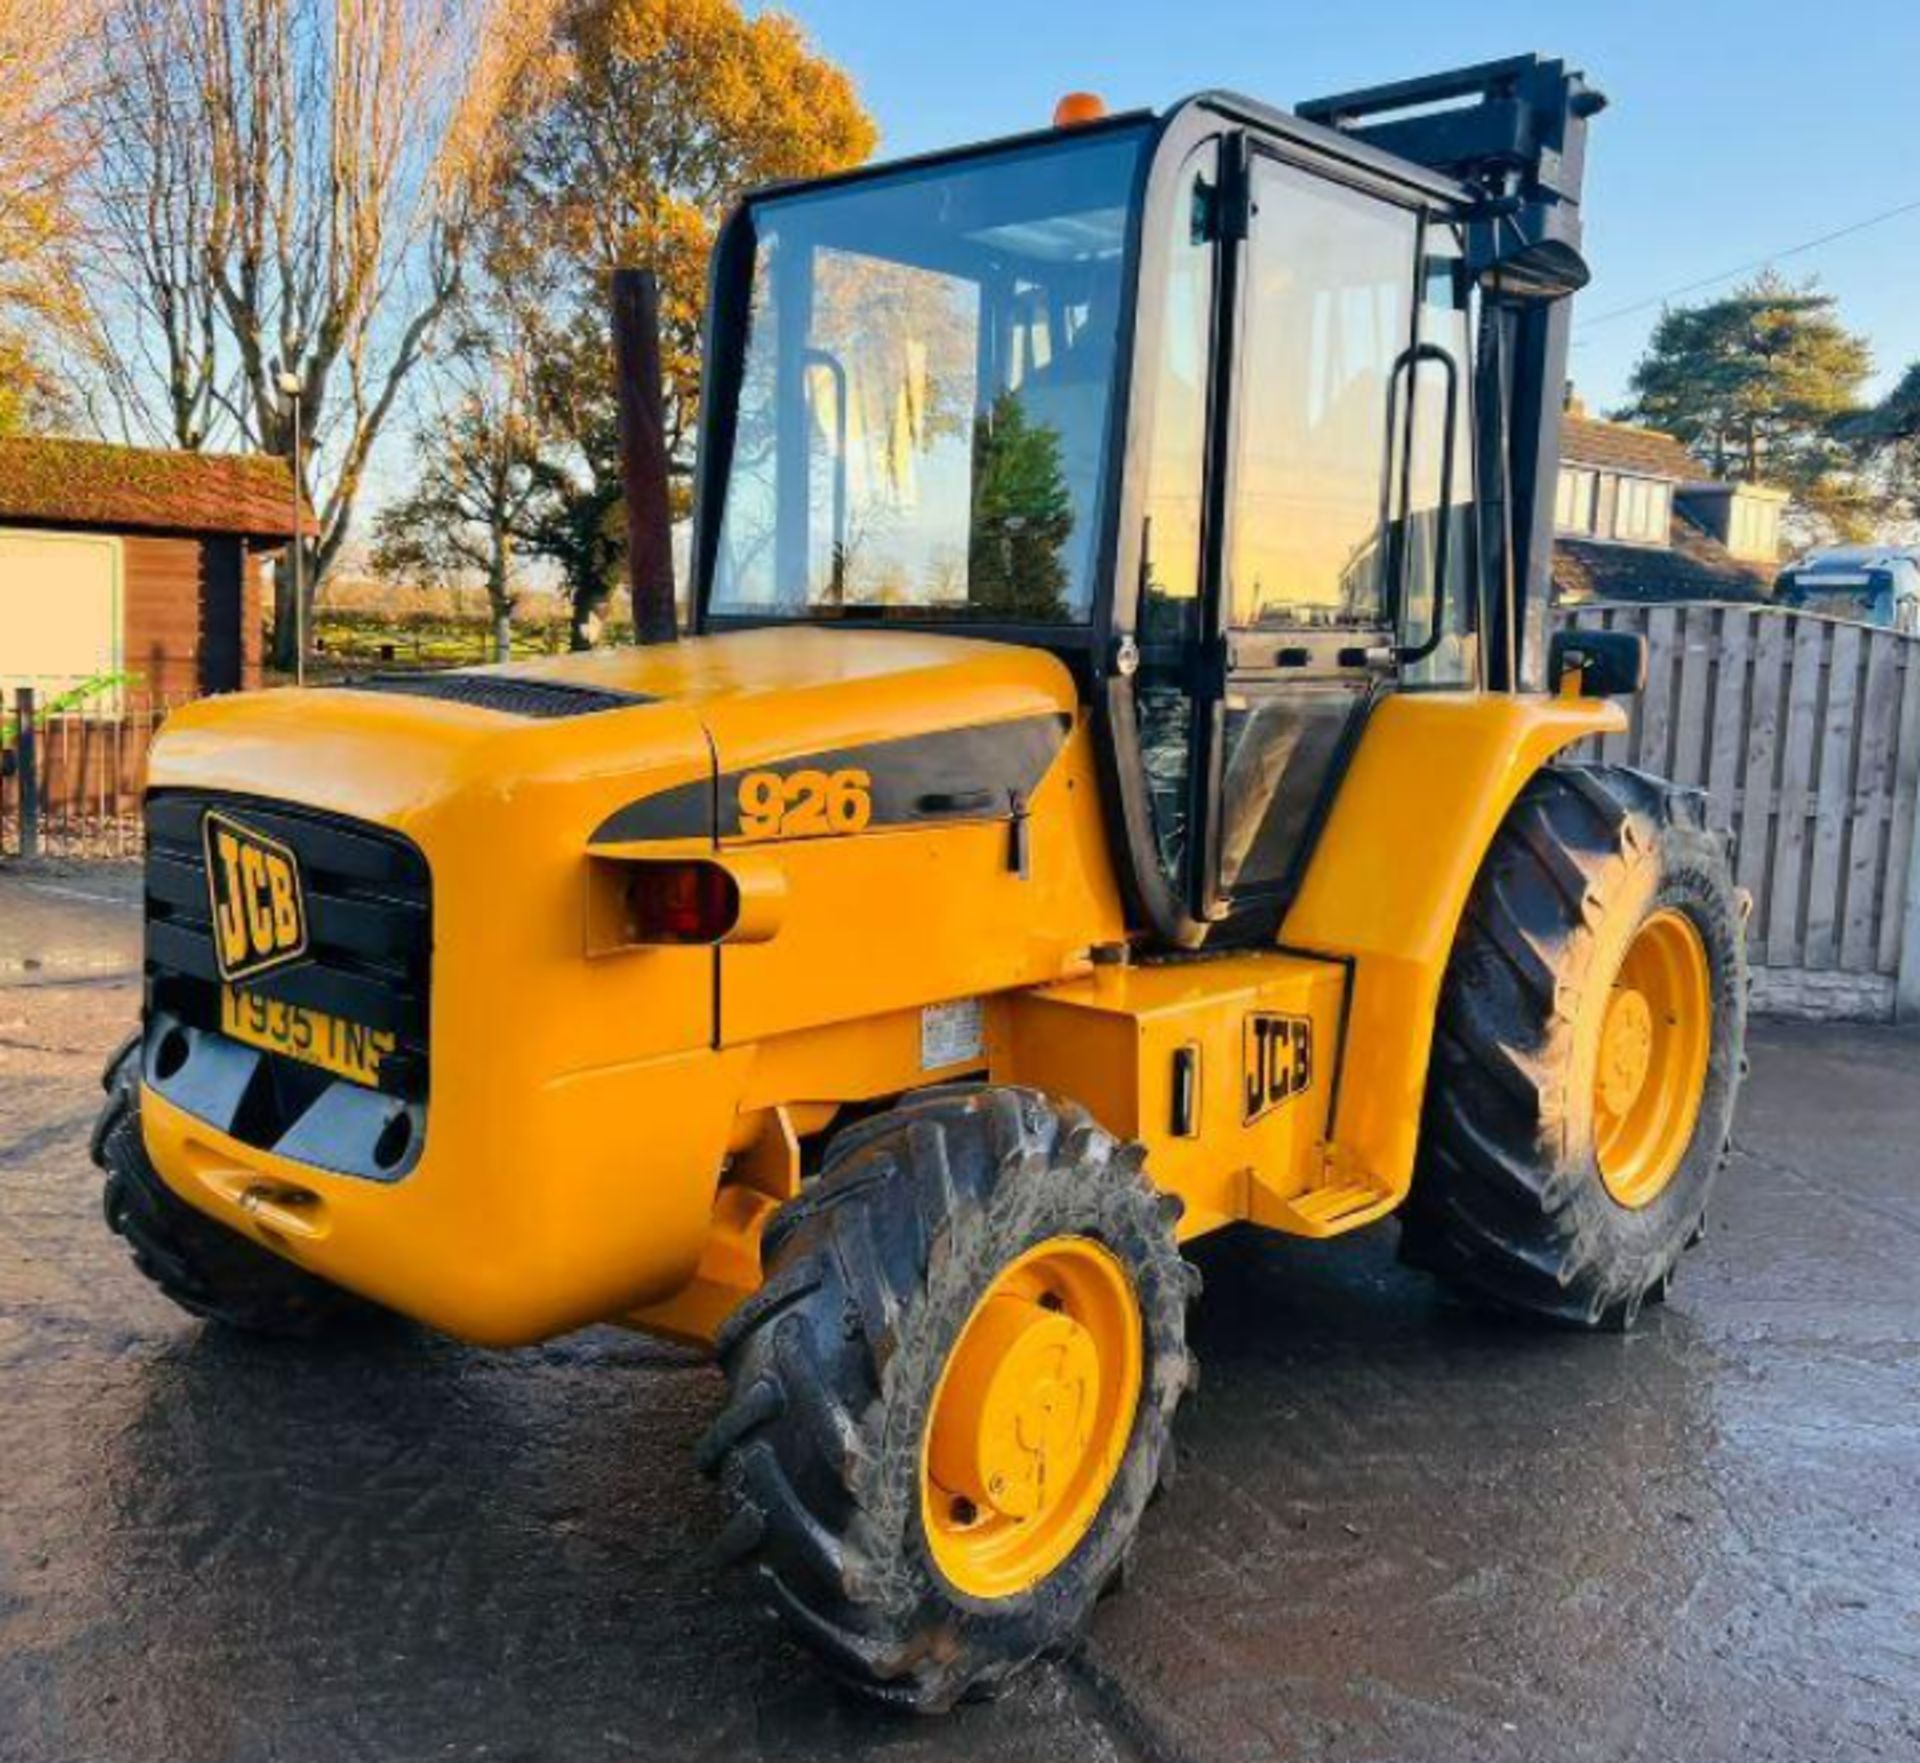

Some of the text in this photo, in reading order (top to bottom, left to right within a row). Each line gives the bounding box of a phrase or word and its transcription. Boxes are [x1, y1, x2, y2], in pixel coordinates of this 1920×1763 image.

[738, 769, 871, 838] 926
[218, 831, 298, 966] JCB
[1247, 1017, 1309, 1117] JCB
